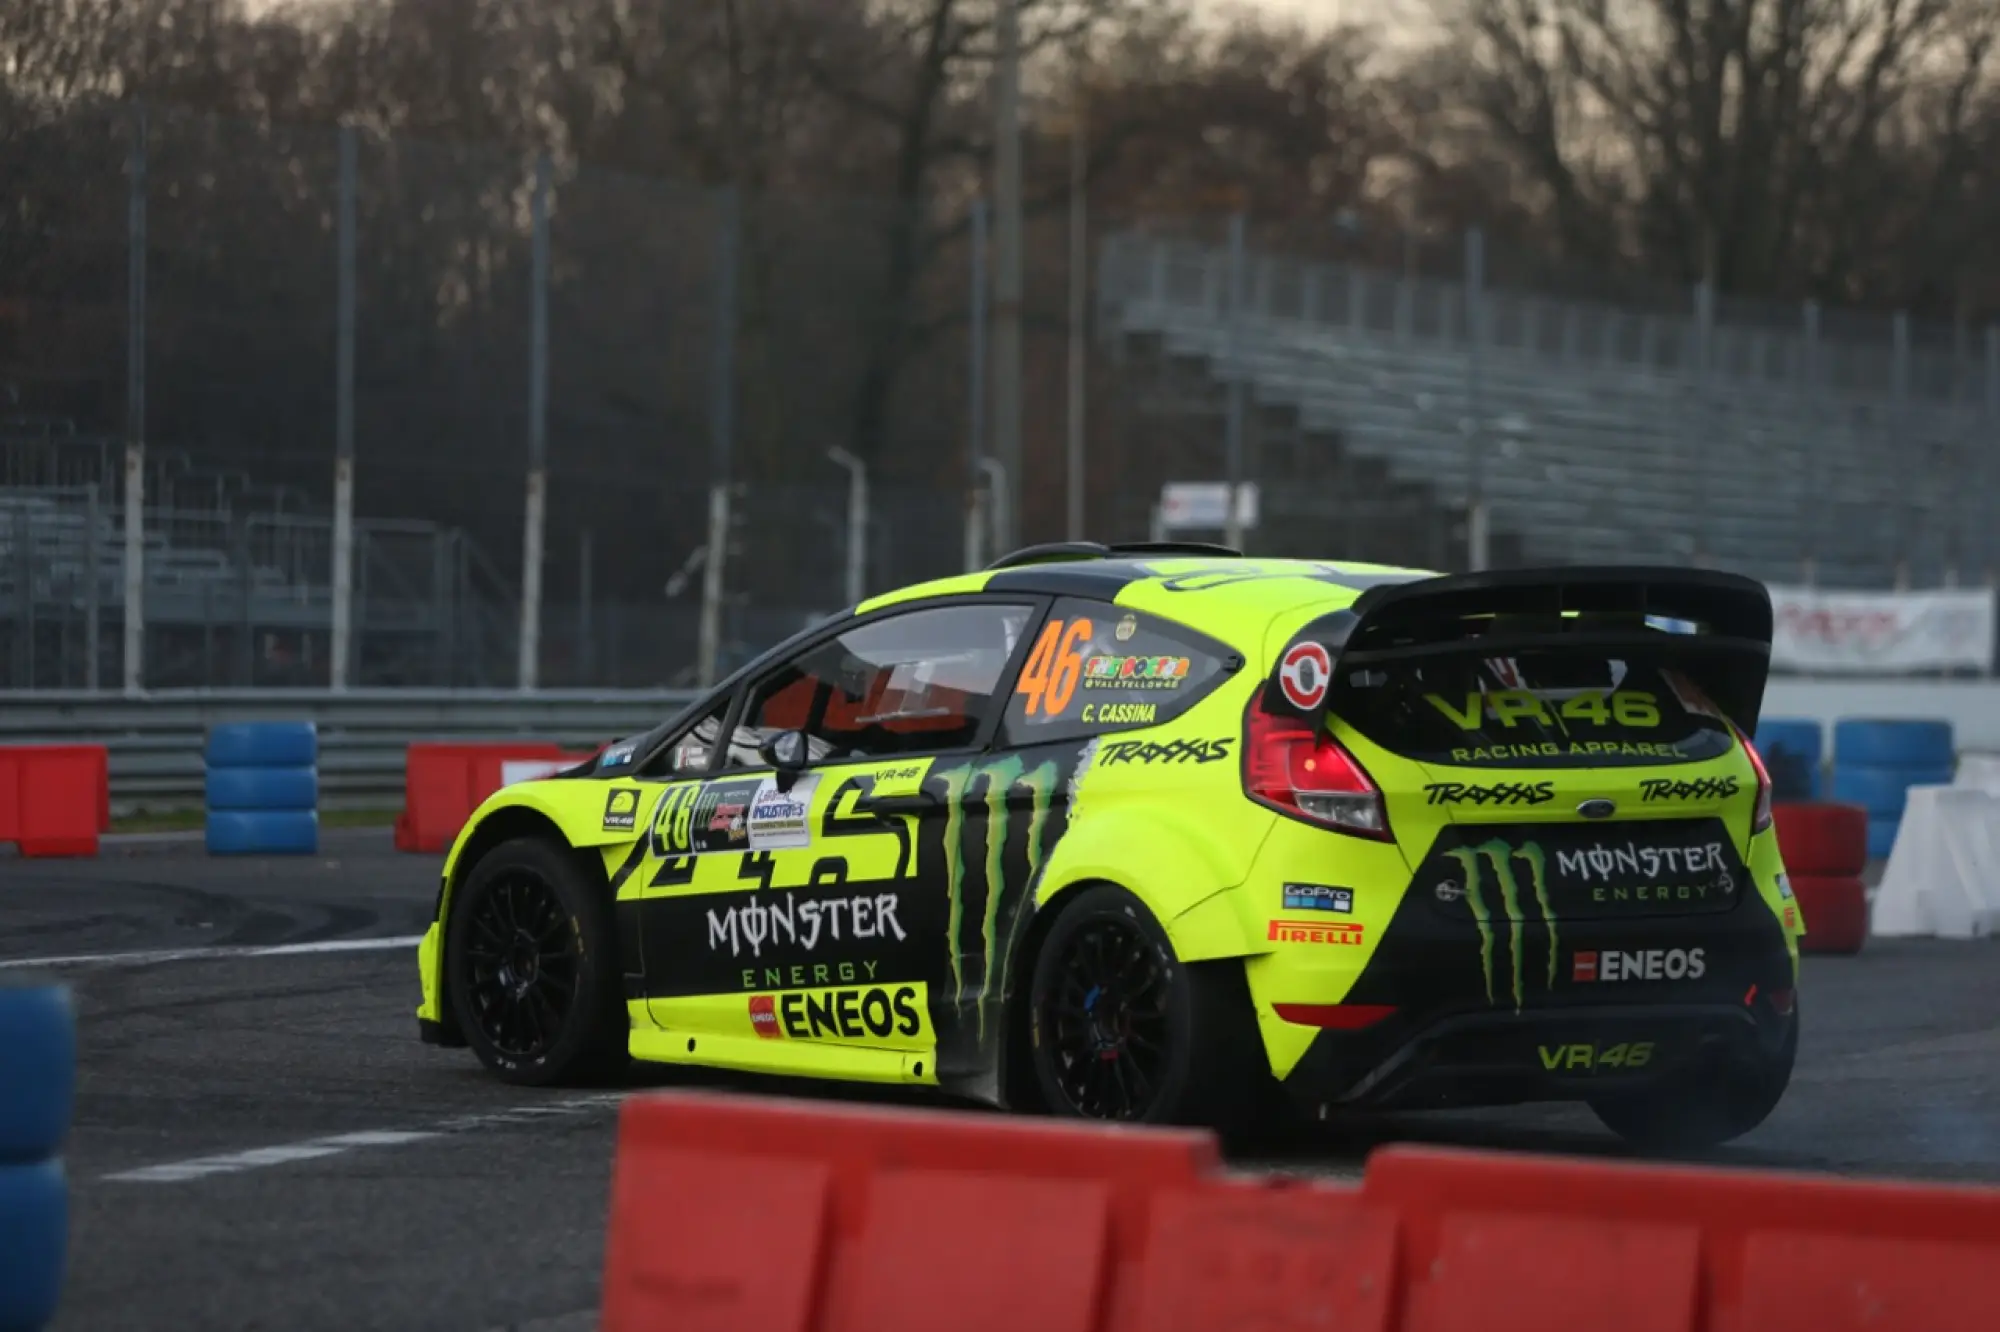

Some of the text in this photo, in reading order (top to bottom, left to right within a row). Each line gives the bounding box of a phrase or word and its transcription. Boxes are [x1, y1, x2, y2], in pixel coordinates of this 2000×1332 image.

[1017, 617, 1092, 716] 46
[1081, 703, 1157, 723] C. CASSINA
[1099, 737, 1235, 767] TRAXXAS
[1451, 740, 1688, 763] RACING APPAREL
[1424, 781, 1555, 805] TRAXXAS
[1639, 775, 1740, 801] TRAXXAS
[654, 784, 700, 851] 46
[1556, 842, 1729, 882] MONSTER
[1285, 885, 1351, 901] GoPro
[1592, 883, 1709, 902] ENERGY
[706, 891, 907, 957] MONSTER
[1267, 920, 1364, 945] PIRELLI
[742, 960, 878, 988] ENERGY
[1600, 948, 1706, 981] ENEOS
[781, 987, 921, 1039] ENEOS
